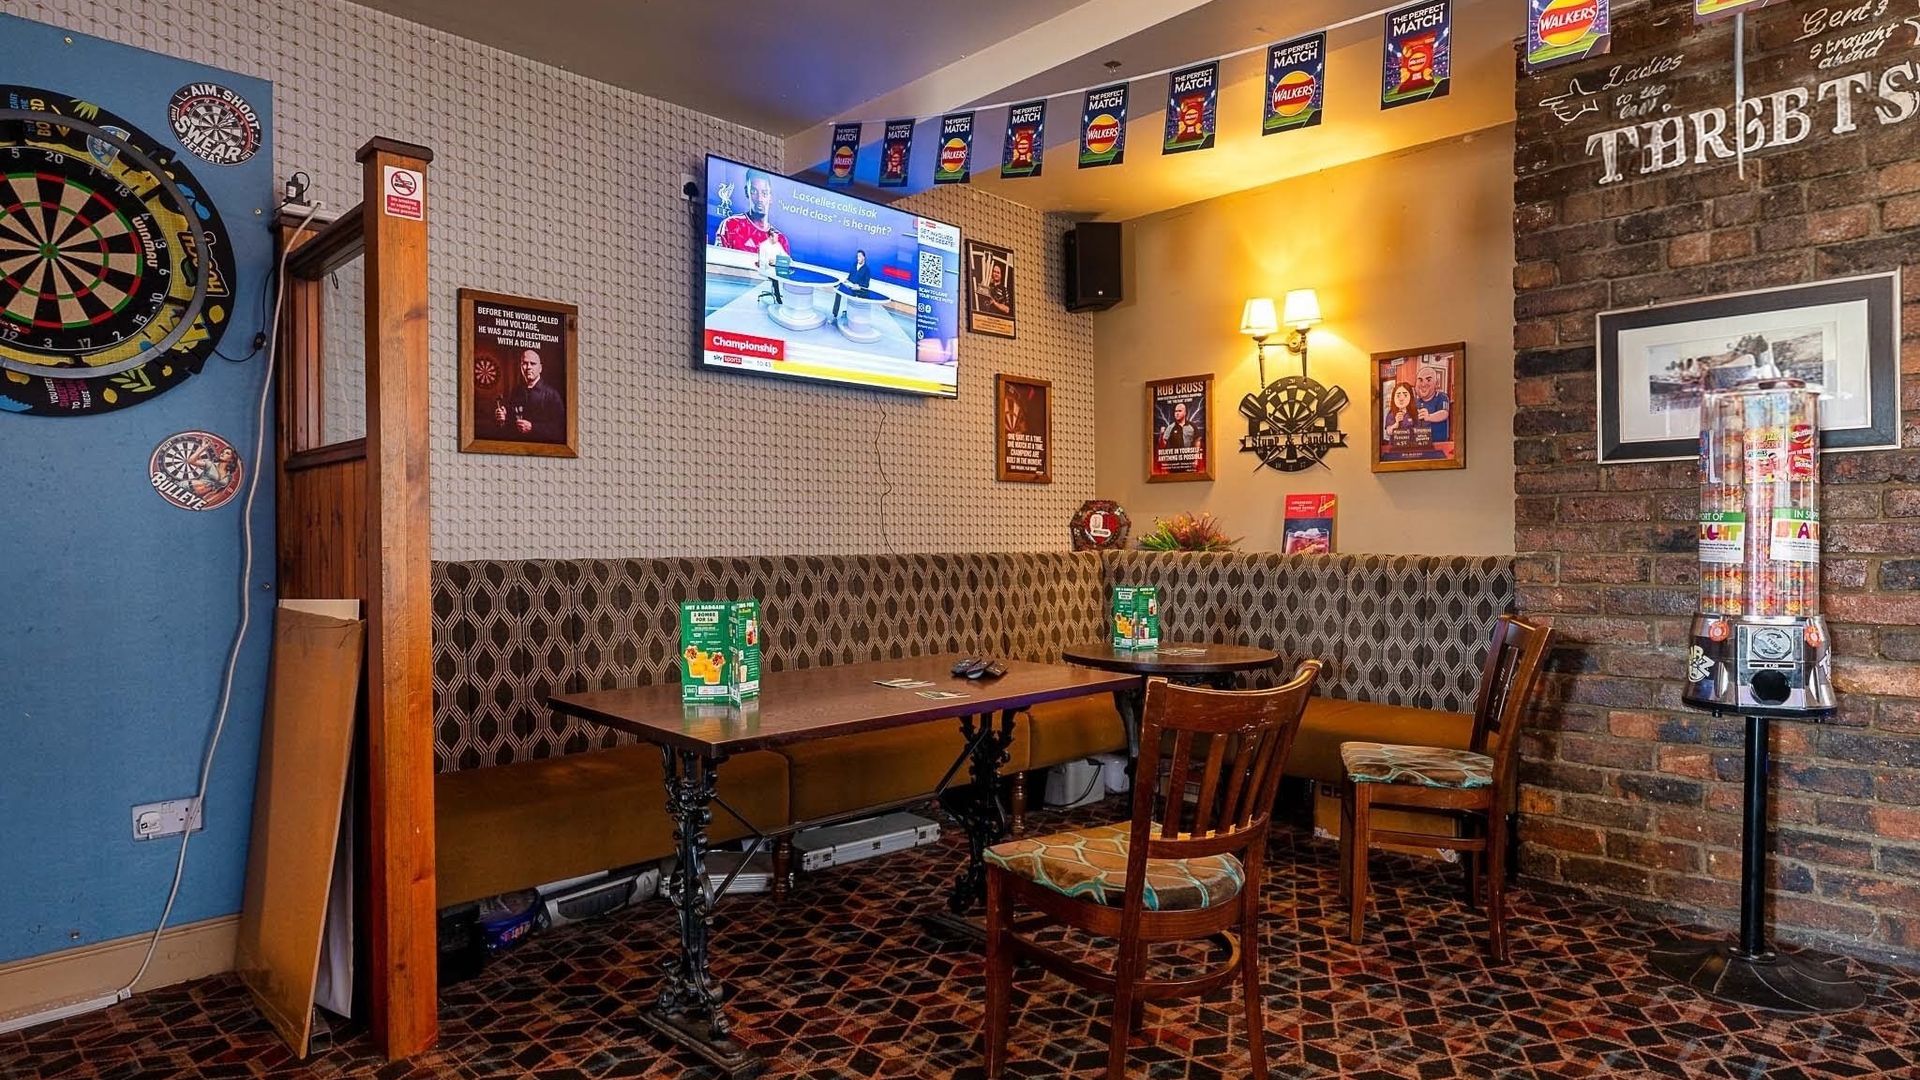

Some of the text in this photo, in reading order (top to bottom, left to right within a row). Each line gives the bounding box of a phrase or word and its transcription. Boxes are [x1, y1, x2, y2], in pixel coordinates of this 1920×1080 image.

[1393, 4, 1445, 24] THE PERFECT
[1541, 4, 1597, 30] WALKERS
[1393, 12, 1444, 37] MATCH
[1274, 40, 1320, 58] THE PERFECT
[1274, 50, 1317, 69] MATCH
[1186, 68, 1214, 80] PERFECT
[1602, 54, 1684, 90] Ladies
[1174, 76, 1212, 92] MATCH
[1100, 88, 1124, 100] PERFECT
[1274, 84, 1314, 103] WALKERS
[1616, 93, 1632, 106] to
[1020, 106, 1042, 114] PERFECT
[1089, 96, 1123, 111] MATCH
[953, 116, 971, 125] PERFECT
[1012, 112, 1040, 124] MATCH
[888, 129, 910, 139] MATCH
[944, 123, 970, 134] MATCH
[1088, 126, 1118, 140] WALKERS
[174, 115, 242, 162] SWEAR
[836, 132, 857, 142] MATCH
[12, 148, 20, 159] 5
[44, 151, 64, 164] 20
[942, 150, 966, 160] WALKERS
[834, 156, 854, 166] WALKERS
[114, 184, 130, 198] 18
[793, 188, 836, 210] Lascelles
[837, 202, 858, 214] calls
[852, 220, 863, 230] he
[864, 220, 892, 236] right?
[154, 237, 167, 249] 13
[150, 292, 164, 303] 10
[132, 314, 148, 326] 15
[478, 306, 559, 325] BEFORE THE WORLD CALLED
[496, 318, 540, 332] HIM VOLTAGE,
[2, 328, 19, 341] 19
[478, 325, 558, 344] HE WAS JUST AN ELECTRICIAN
[43, 338, 53, 349] 3
[498, 336, 541, 350] WITH A DREAM
[712, 336, 779, 356] Championship
[1176, 381, 1204, 394] CROSS
[152, 472, 208, 511] BULLEYE
[1712, 512, 1724, 521] OF
[1794, 510, 1804, 518] IN
